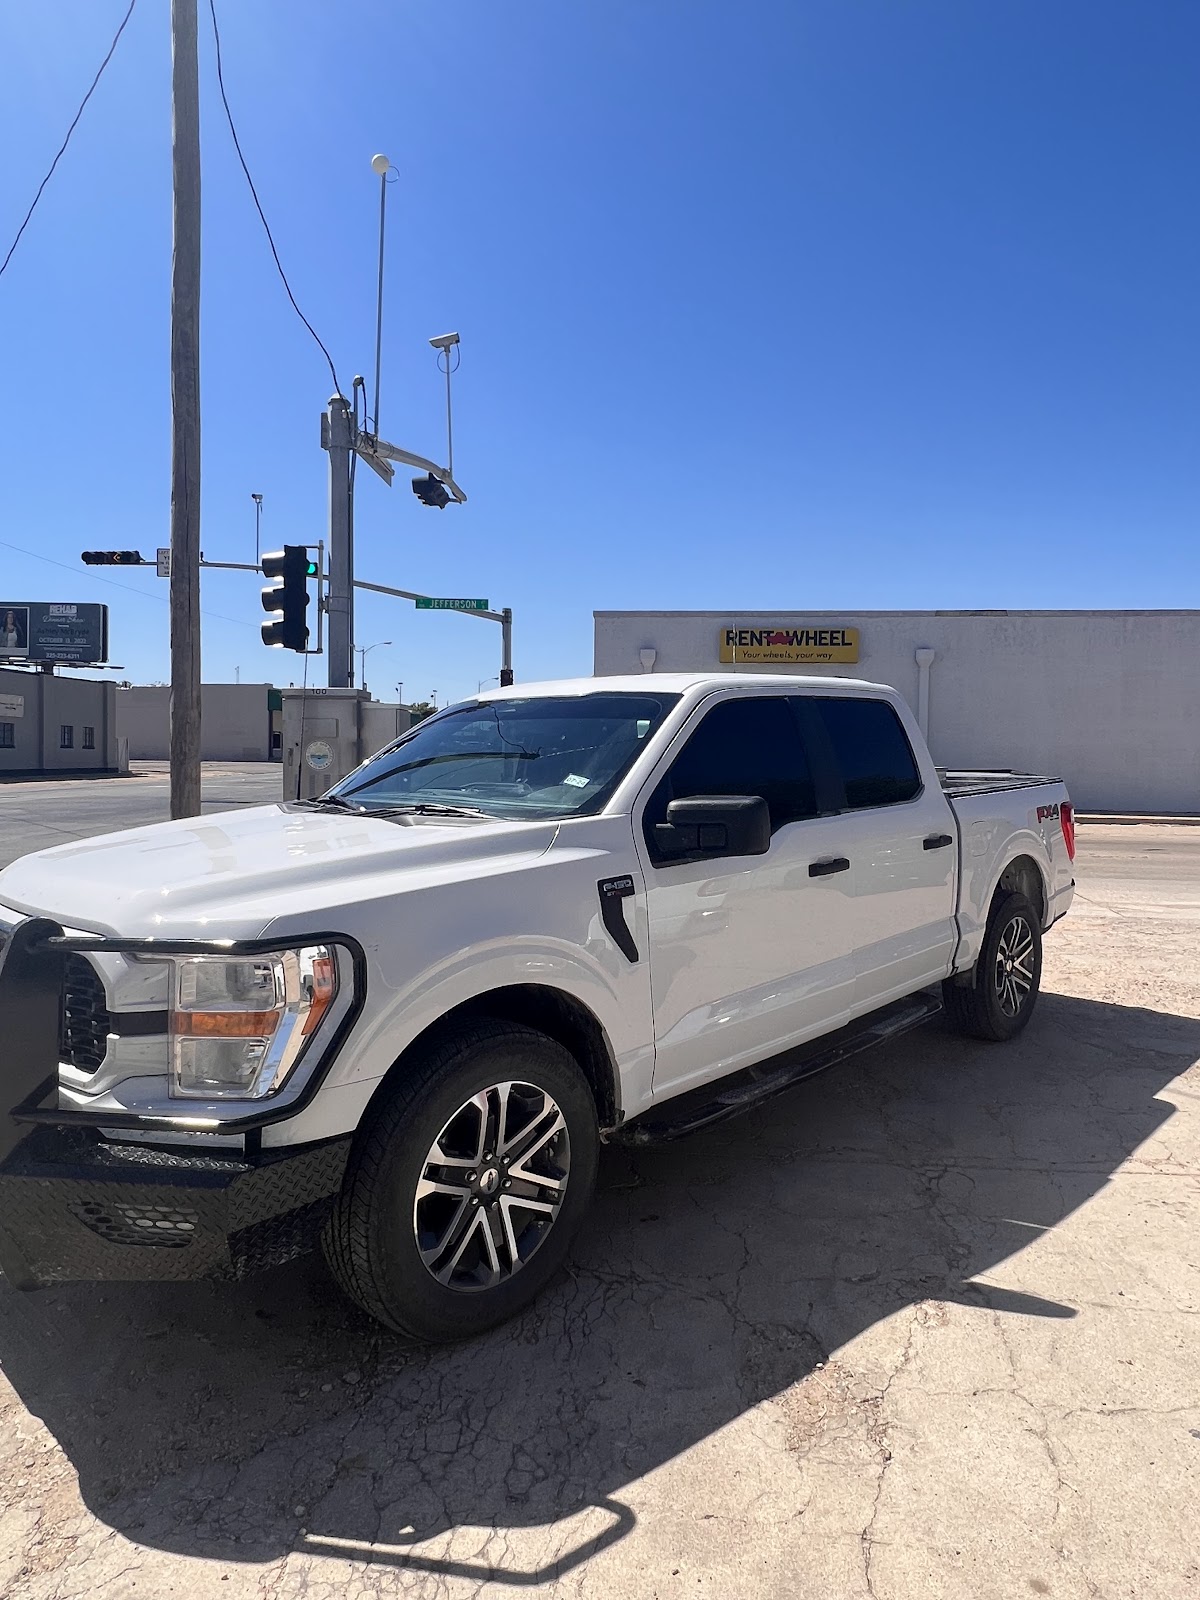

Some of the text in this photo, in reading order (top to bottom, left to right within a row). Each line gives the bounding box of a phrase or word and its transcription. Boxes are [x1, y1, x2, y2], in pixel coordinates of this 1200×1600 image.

[50, 604, 77, 614] REHAB
[429, 600, 477, 609] JEFFERSON
[742, 650, 833, 660] Your wheels, your way
[1036, 803, 1060, 823] FX4
